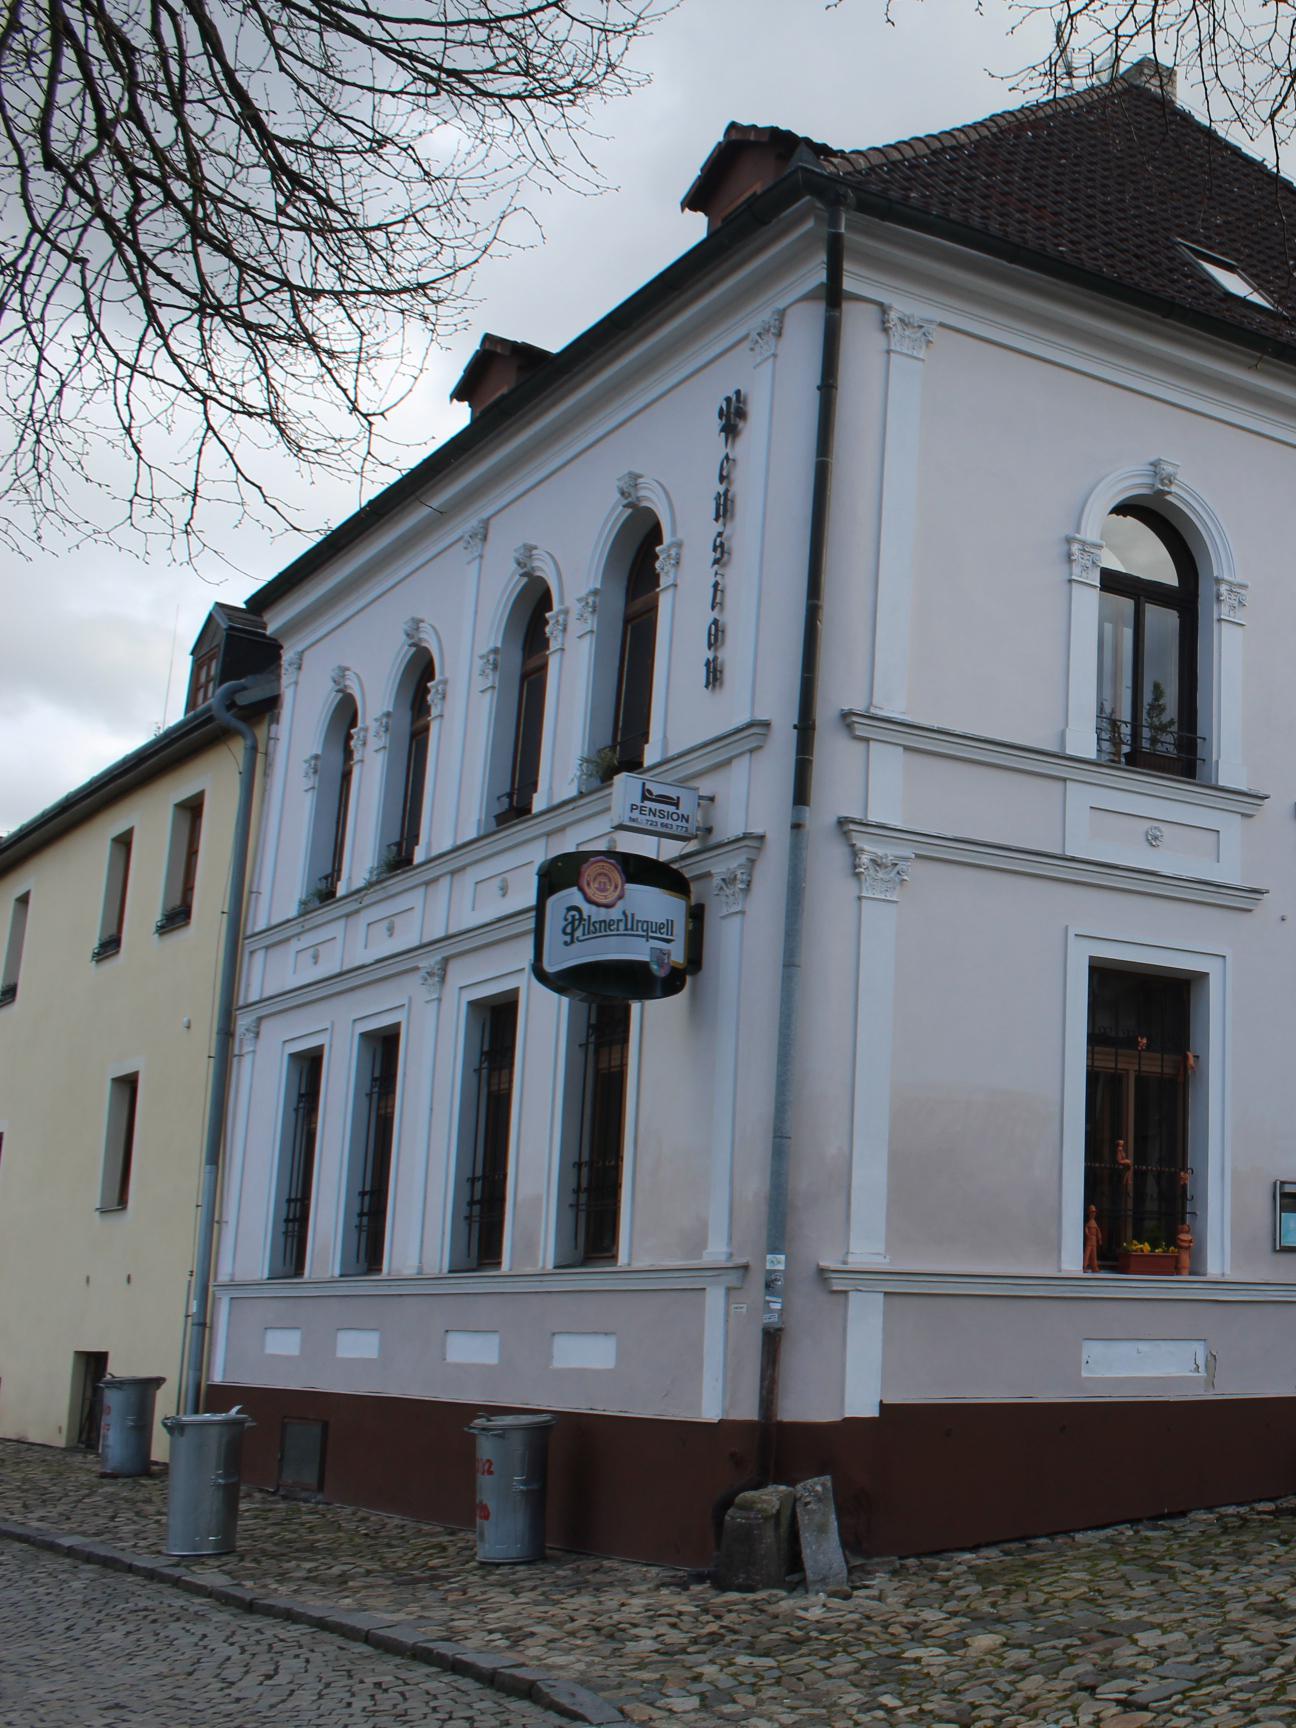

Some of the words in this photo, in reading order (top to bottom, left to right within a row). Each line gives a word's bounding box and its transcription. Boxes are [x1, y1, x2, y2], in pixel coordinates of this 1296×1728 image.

[630, 803, 690, 824] PENSION
[562, 905, 622, 946] Pilsner
[622, 909, 675, 942] Urquell
